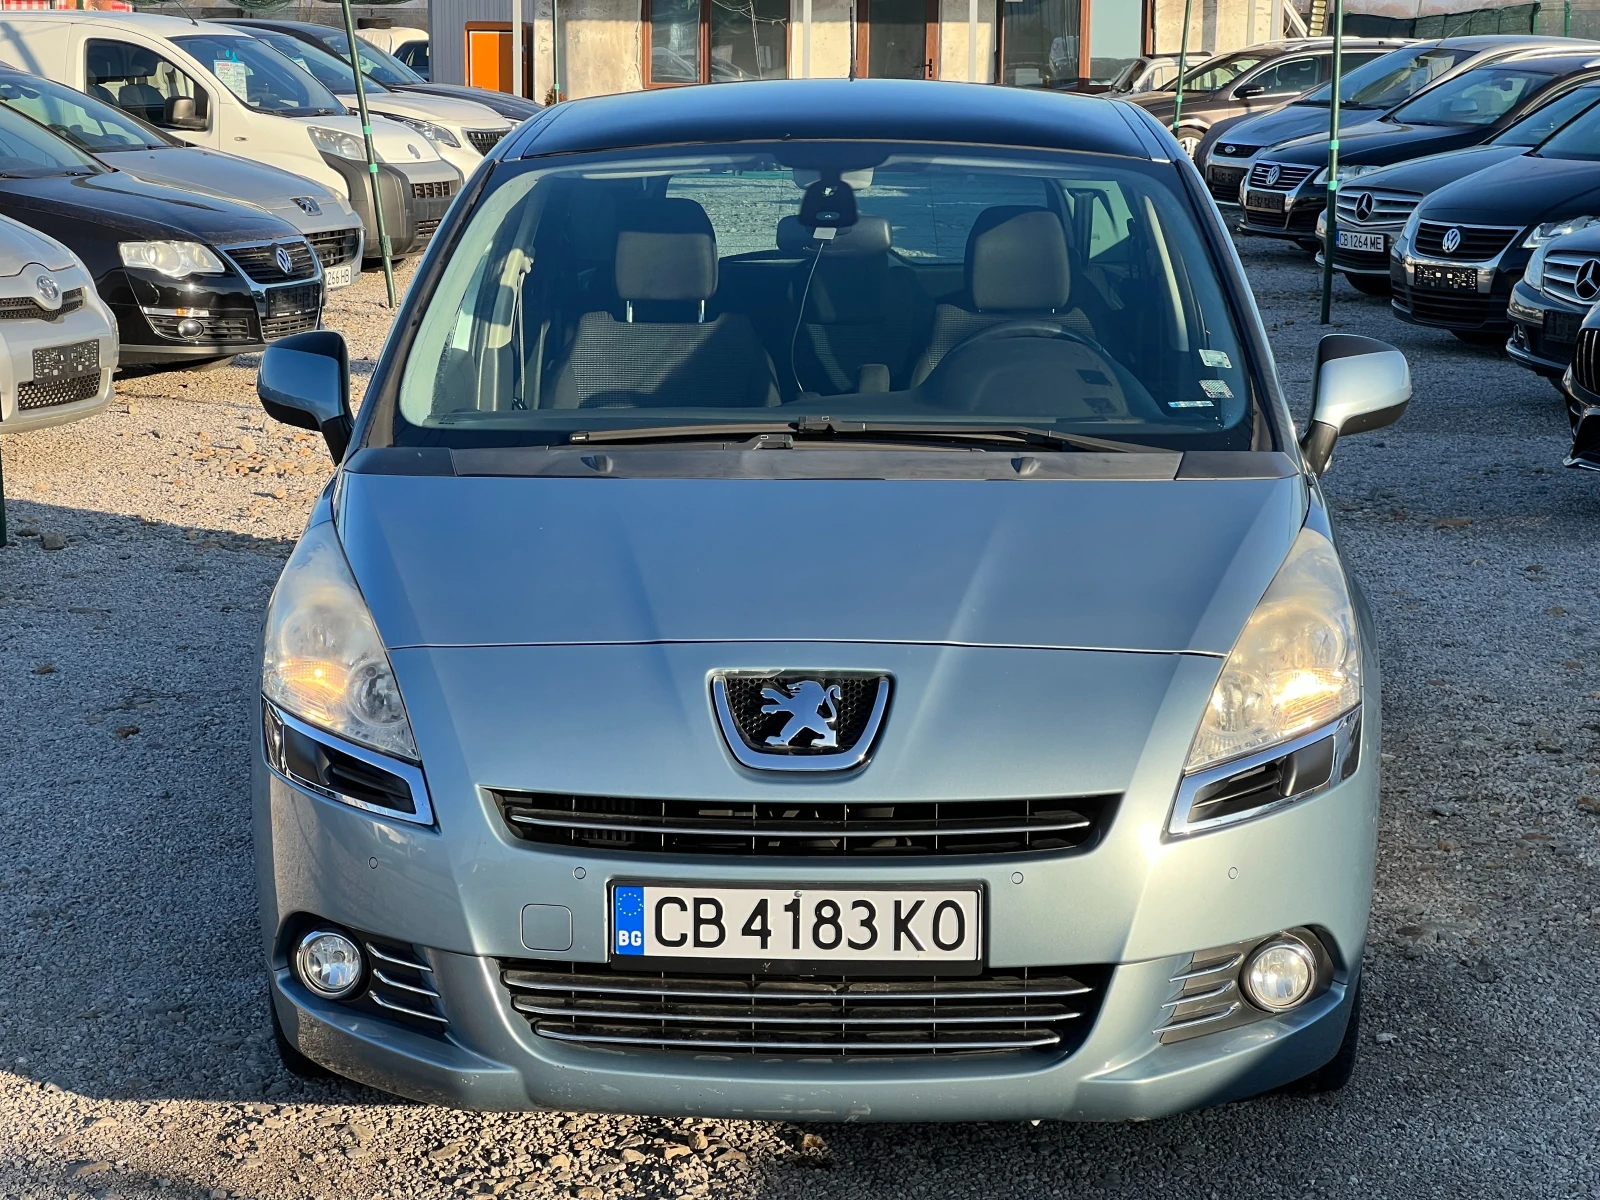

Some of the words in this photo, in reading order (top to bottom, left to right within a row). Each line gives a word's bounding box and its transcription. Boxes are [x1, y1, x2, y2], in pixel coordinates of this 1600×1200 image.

[1339, 233, 1348, 247] CB
[1350, 234, 1368, 249] 1264
[1370, 236, 1382, 250] ME
[654, 896, 727, 949] CB
[741, 898, 879, 951] 4183
[893, 898, 966, 952] KO
[618, 930, 642, 947] BG
